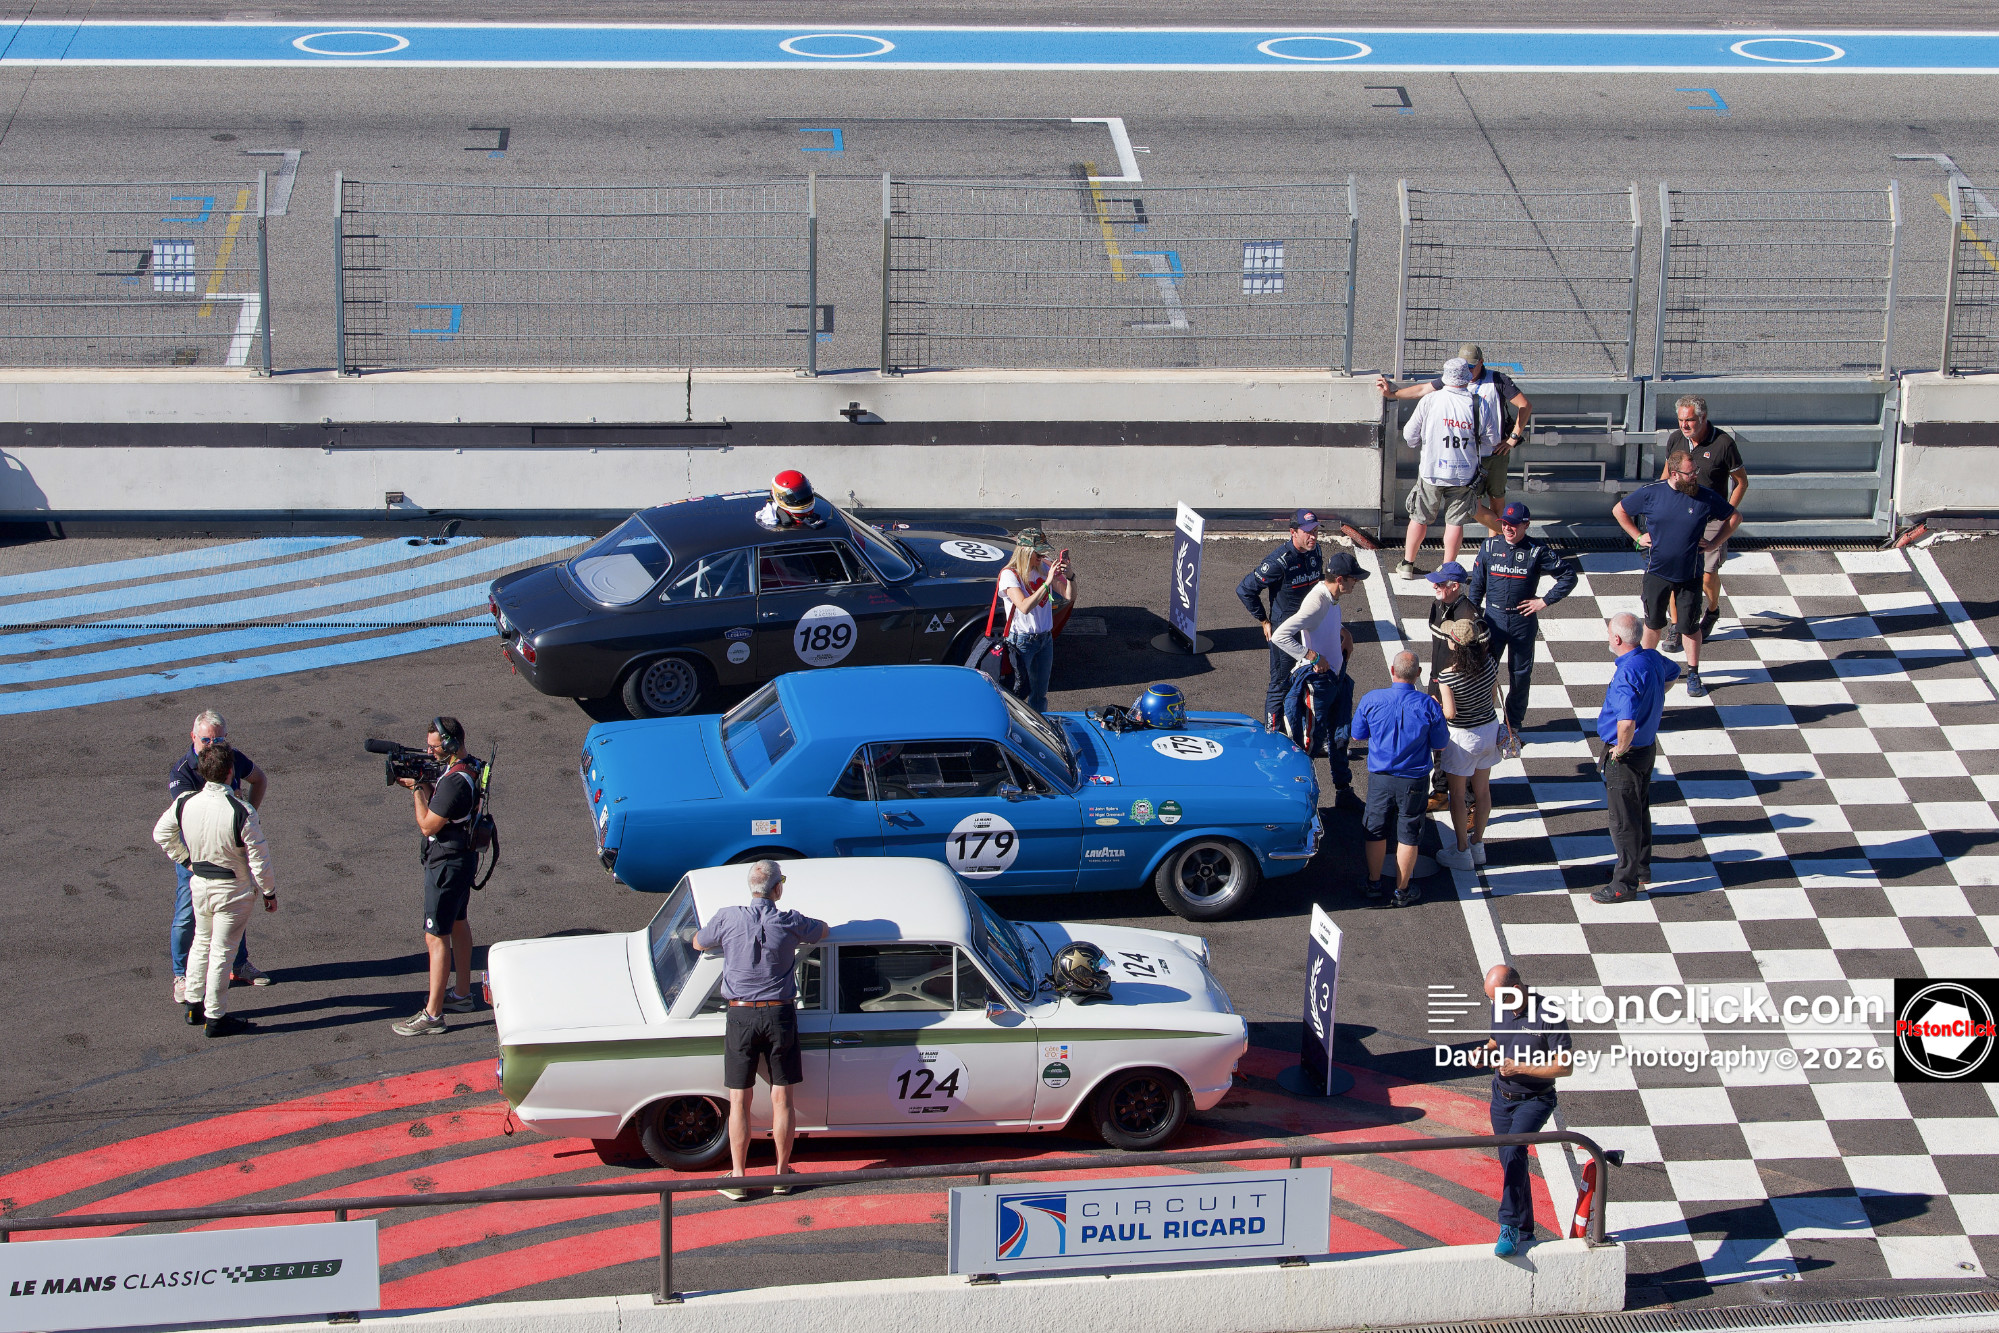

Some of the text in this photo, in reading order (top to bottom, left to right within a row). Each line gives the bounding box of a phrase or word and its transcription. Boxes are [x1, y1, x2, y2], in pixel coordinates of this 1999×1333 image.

[1443, 418, 1473, 430] TRACK
[1442, 435, 1469, 449] 187
[954, 541, 992, 560] 189
[1185, 562, 1195, 588] 2
[1490, 563, 1528, 575] alfaholics
[800, 623, 852, 652] 189
[1170, 736, 1203, 755] 179
[955, 831, 1014, 860] 179
[1085, 847, 1126, 858] LAVAZZA
[1118, 951, 1157, 978] 124
[1319, 982, 1330, 1012] 3
[897, 1068, 960, 1099] 124
[1082, 1194, 1267, 1218] CIRCUIT
[1082, 1217, 1266, 1243] PAUL RICARD
[9, 1263, 334, 1296] LE MANS CLASSIC SERIES
